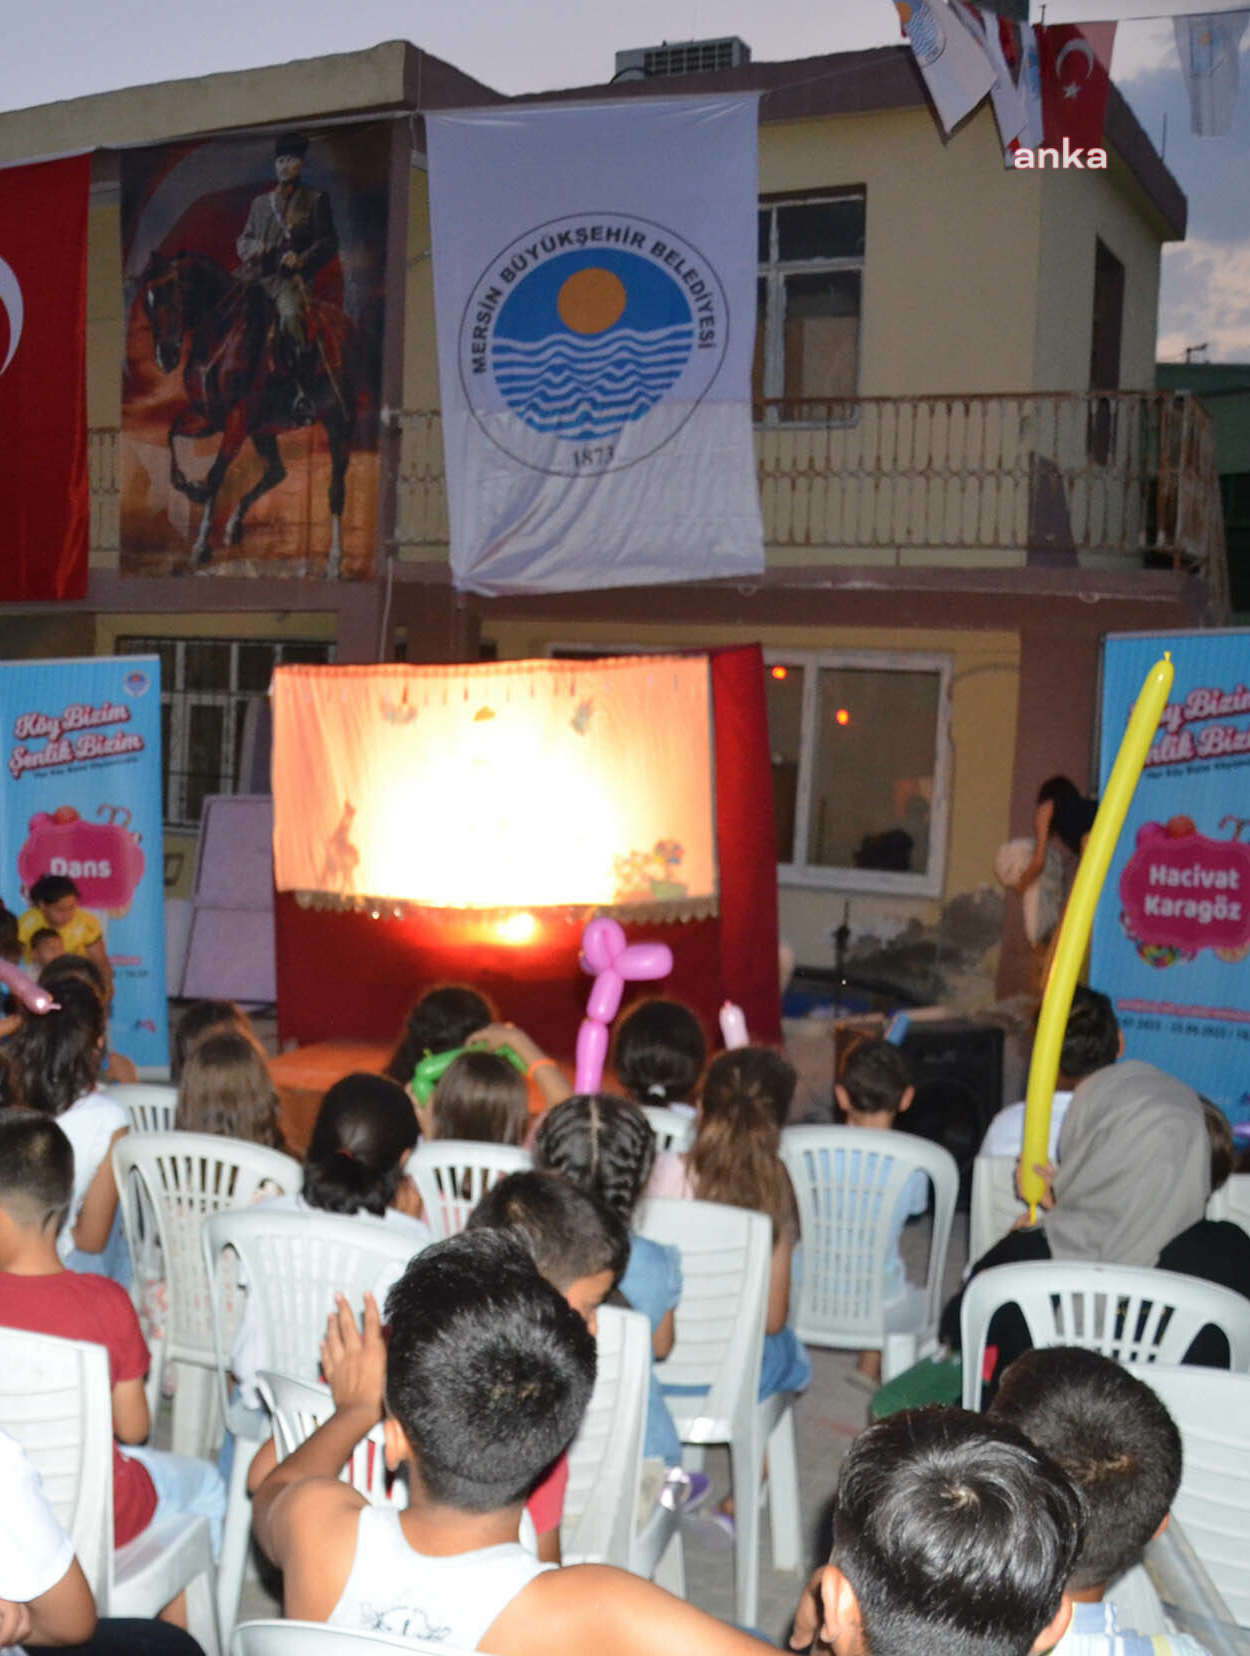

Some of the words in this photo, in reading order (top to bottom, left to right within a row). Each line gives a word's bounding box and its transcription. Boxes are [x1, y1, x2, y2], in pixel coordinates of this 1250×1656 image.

[471, 286, 502, 374] MERSİN
[500, 225, 646, 284] BÜYÜKŞEHİR
[651, 241, 716, 349] BELEDİYESİ
[14, 711, 64, 742] Köy
[61, 700, 131, 732] Bizim
[9, 738, 76, 780] Şenlik
[74, 729, 145, 761] Bizim
[50, 857, 111, 878] Dans
[1149, 862, 1239, 890] Hacivat
[1144, 893, 1242, 924] Karagöz
